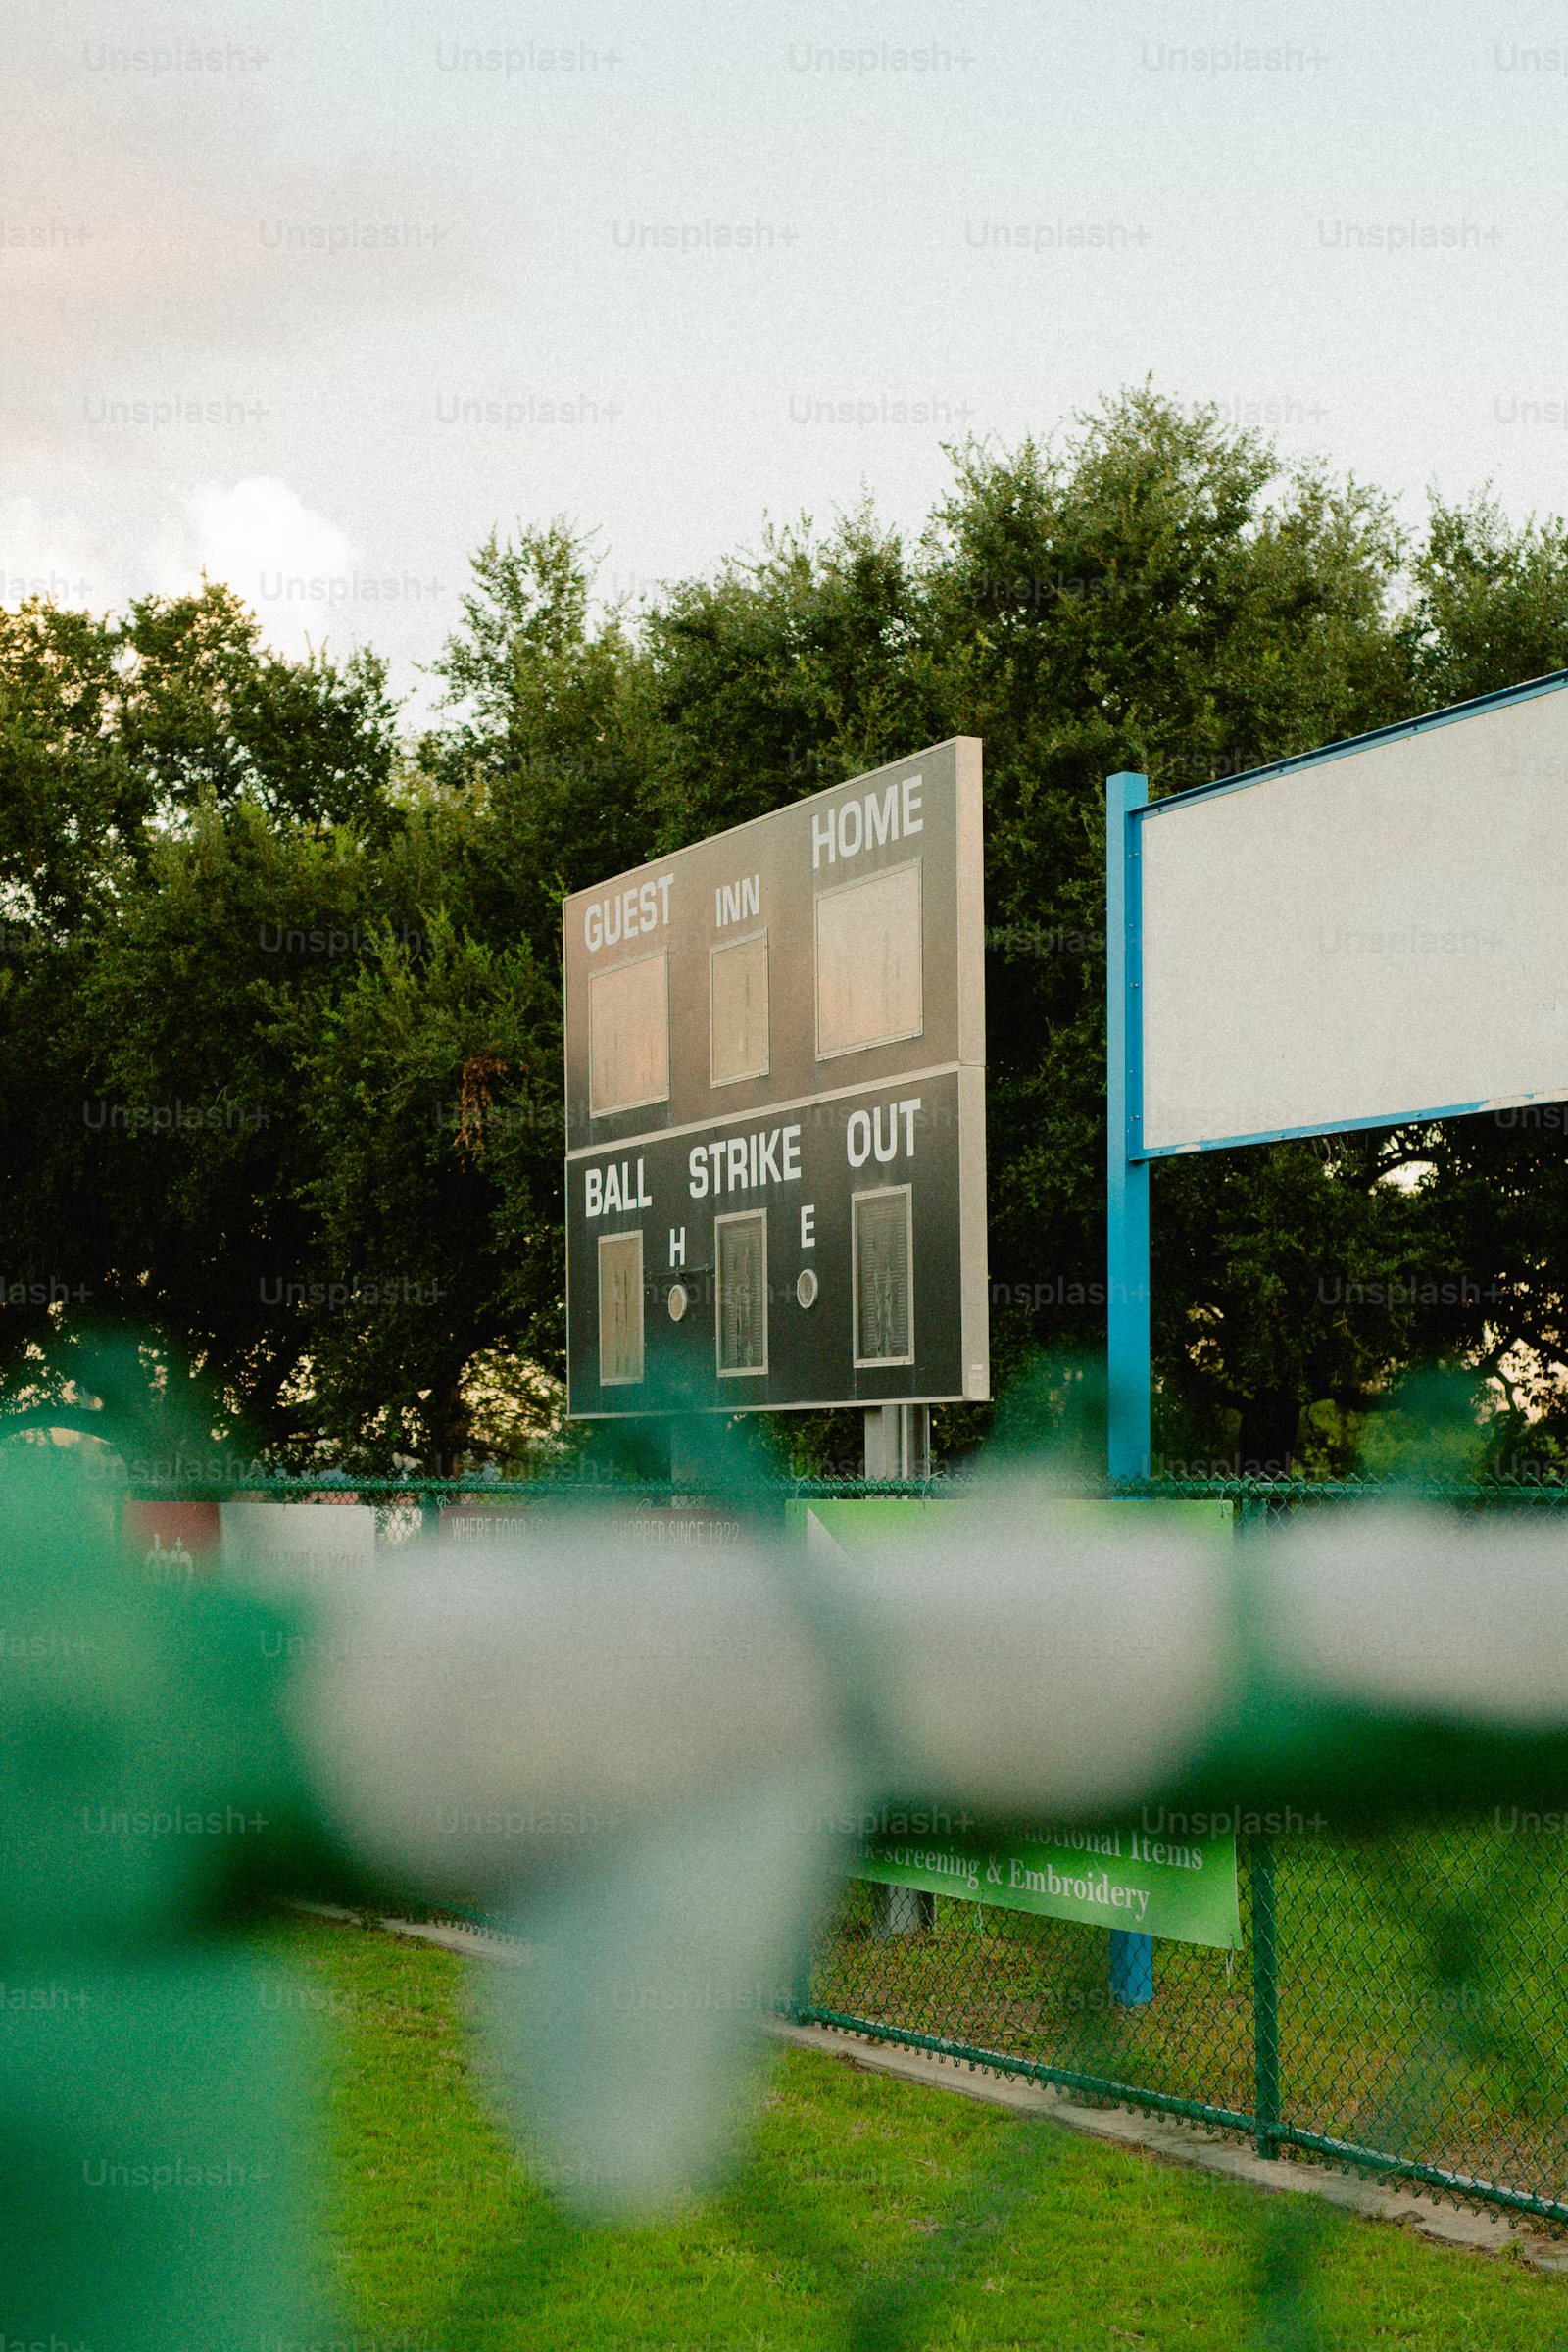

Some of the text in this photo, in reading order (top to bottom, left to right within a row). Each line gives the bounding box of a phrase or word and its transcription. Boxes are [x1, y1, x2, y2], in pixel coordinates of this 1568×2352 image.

[584, 872, 674, 953] GUEST
[715, 873, 760, 929] INN
[811, 774, 924, 870] HOME
[584, 1098, 922, 1218] BALL STRIKE OUT
[668, 1204, 815, 1268] H E
[1130, 1830, 1204, 1871] Items
[985, 1853, 1003, 1886] &
[1009, 1854, 1151, 1923] Embroidery
